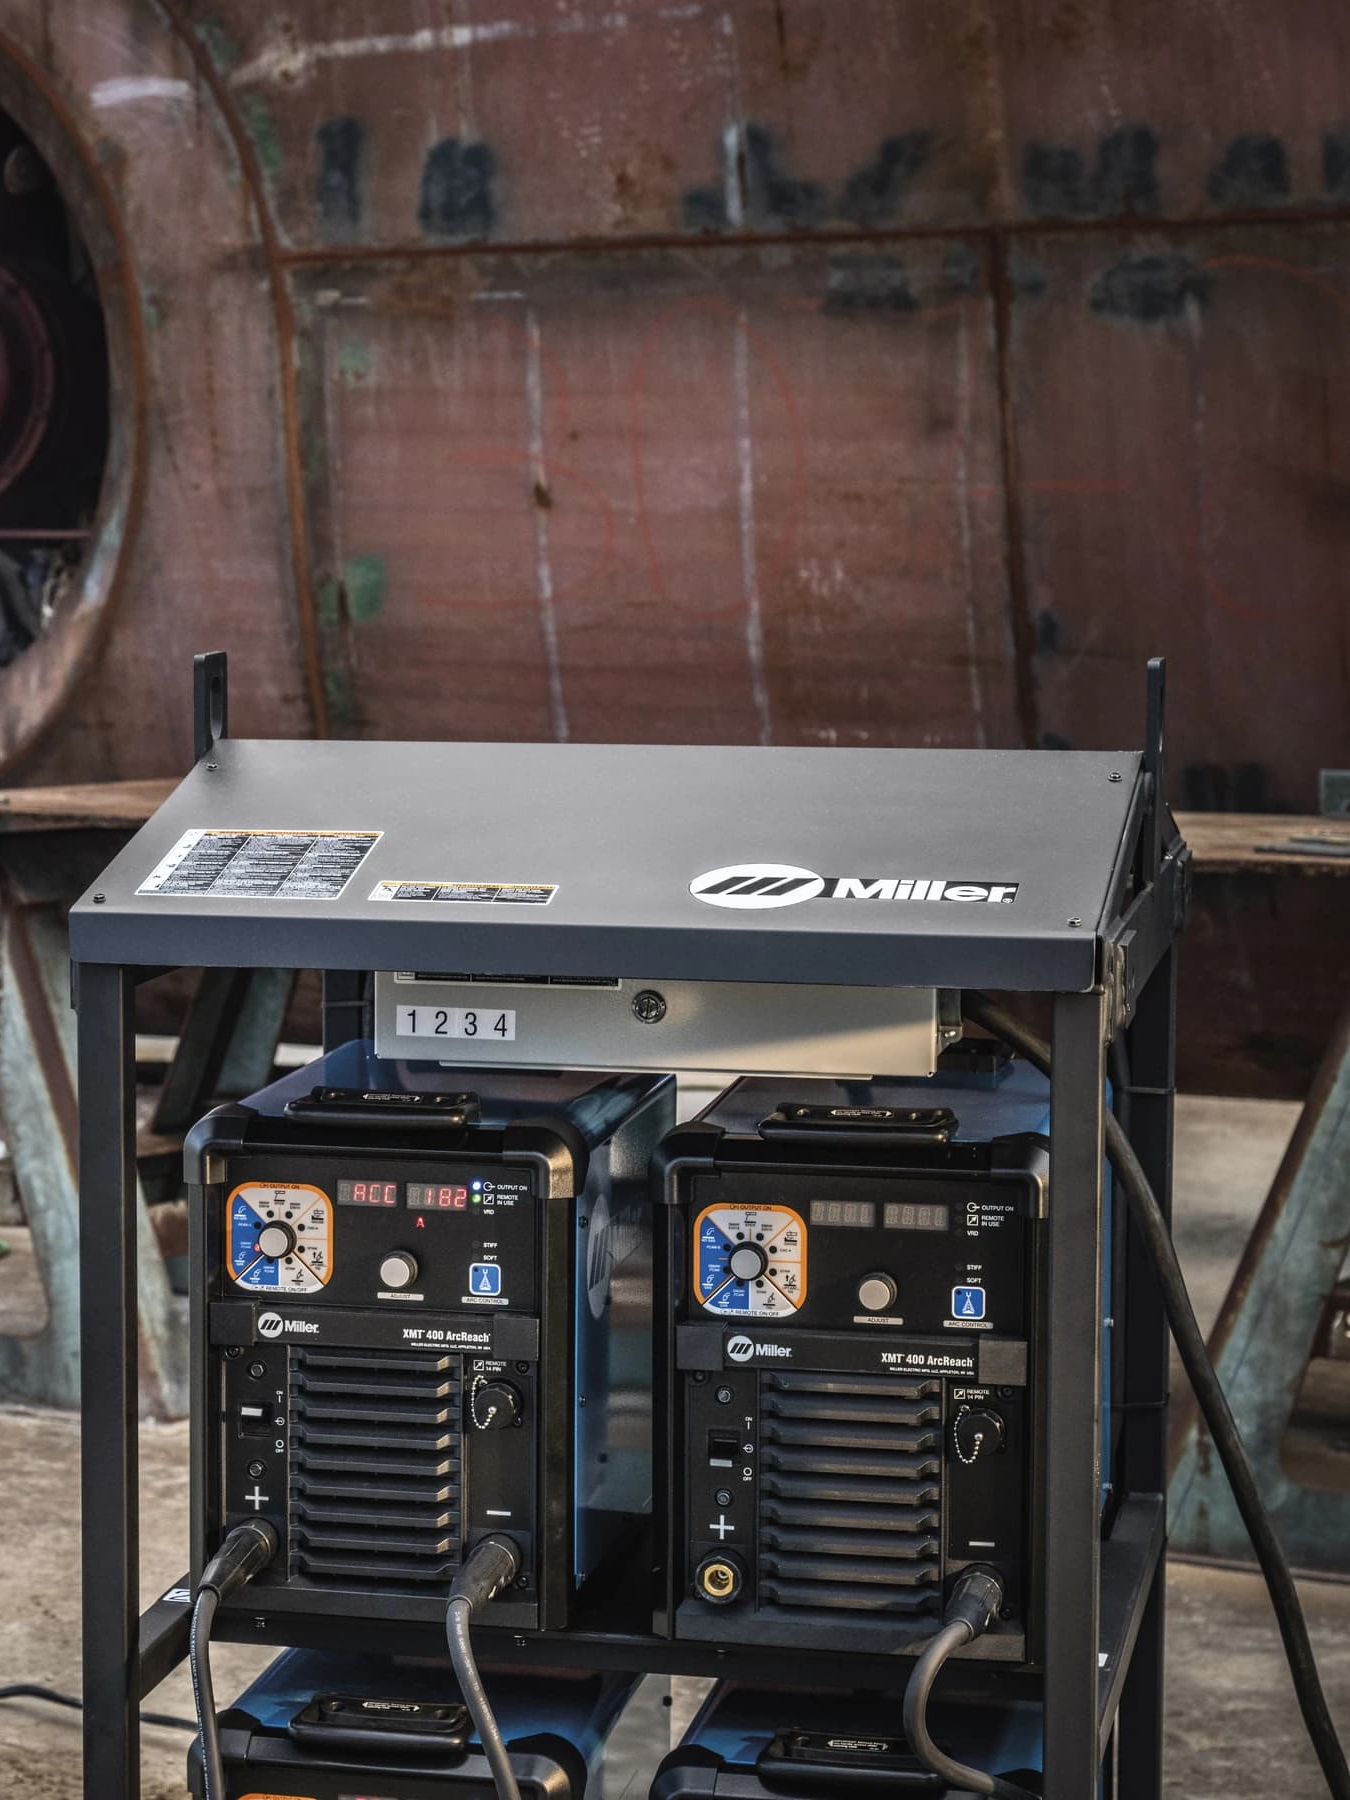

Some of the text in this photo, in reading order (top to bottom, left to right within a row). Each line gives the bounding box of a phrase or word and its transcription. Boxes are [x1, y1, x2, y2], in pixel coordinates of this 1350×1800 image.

[832, 878, 1018, 903] Miller
[407, 1010, 507, 1037] 1 2 3 4
[426, 1188, 467, 1207] 182
[416, 1217, 425, 1227] A
[284, 1320, 318, 1334] Miller
[403, 1329, 490, 1343] XMT 400 ArcReach
[755, 1343, 791, 1357] Miller
[881, 1352, 973, 1367] XMT 400 ArcReach
